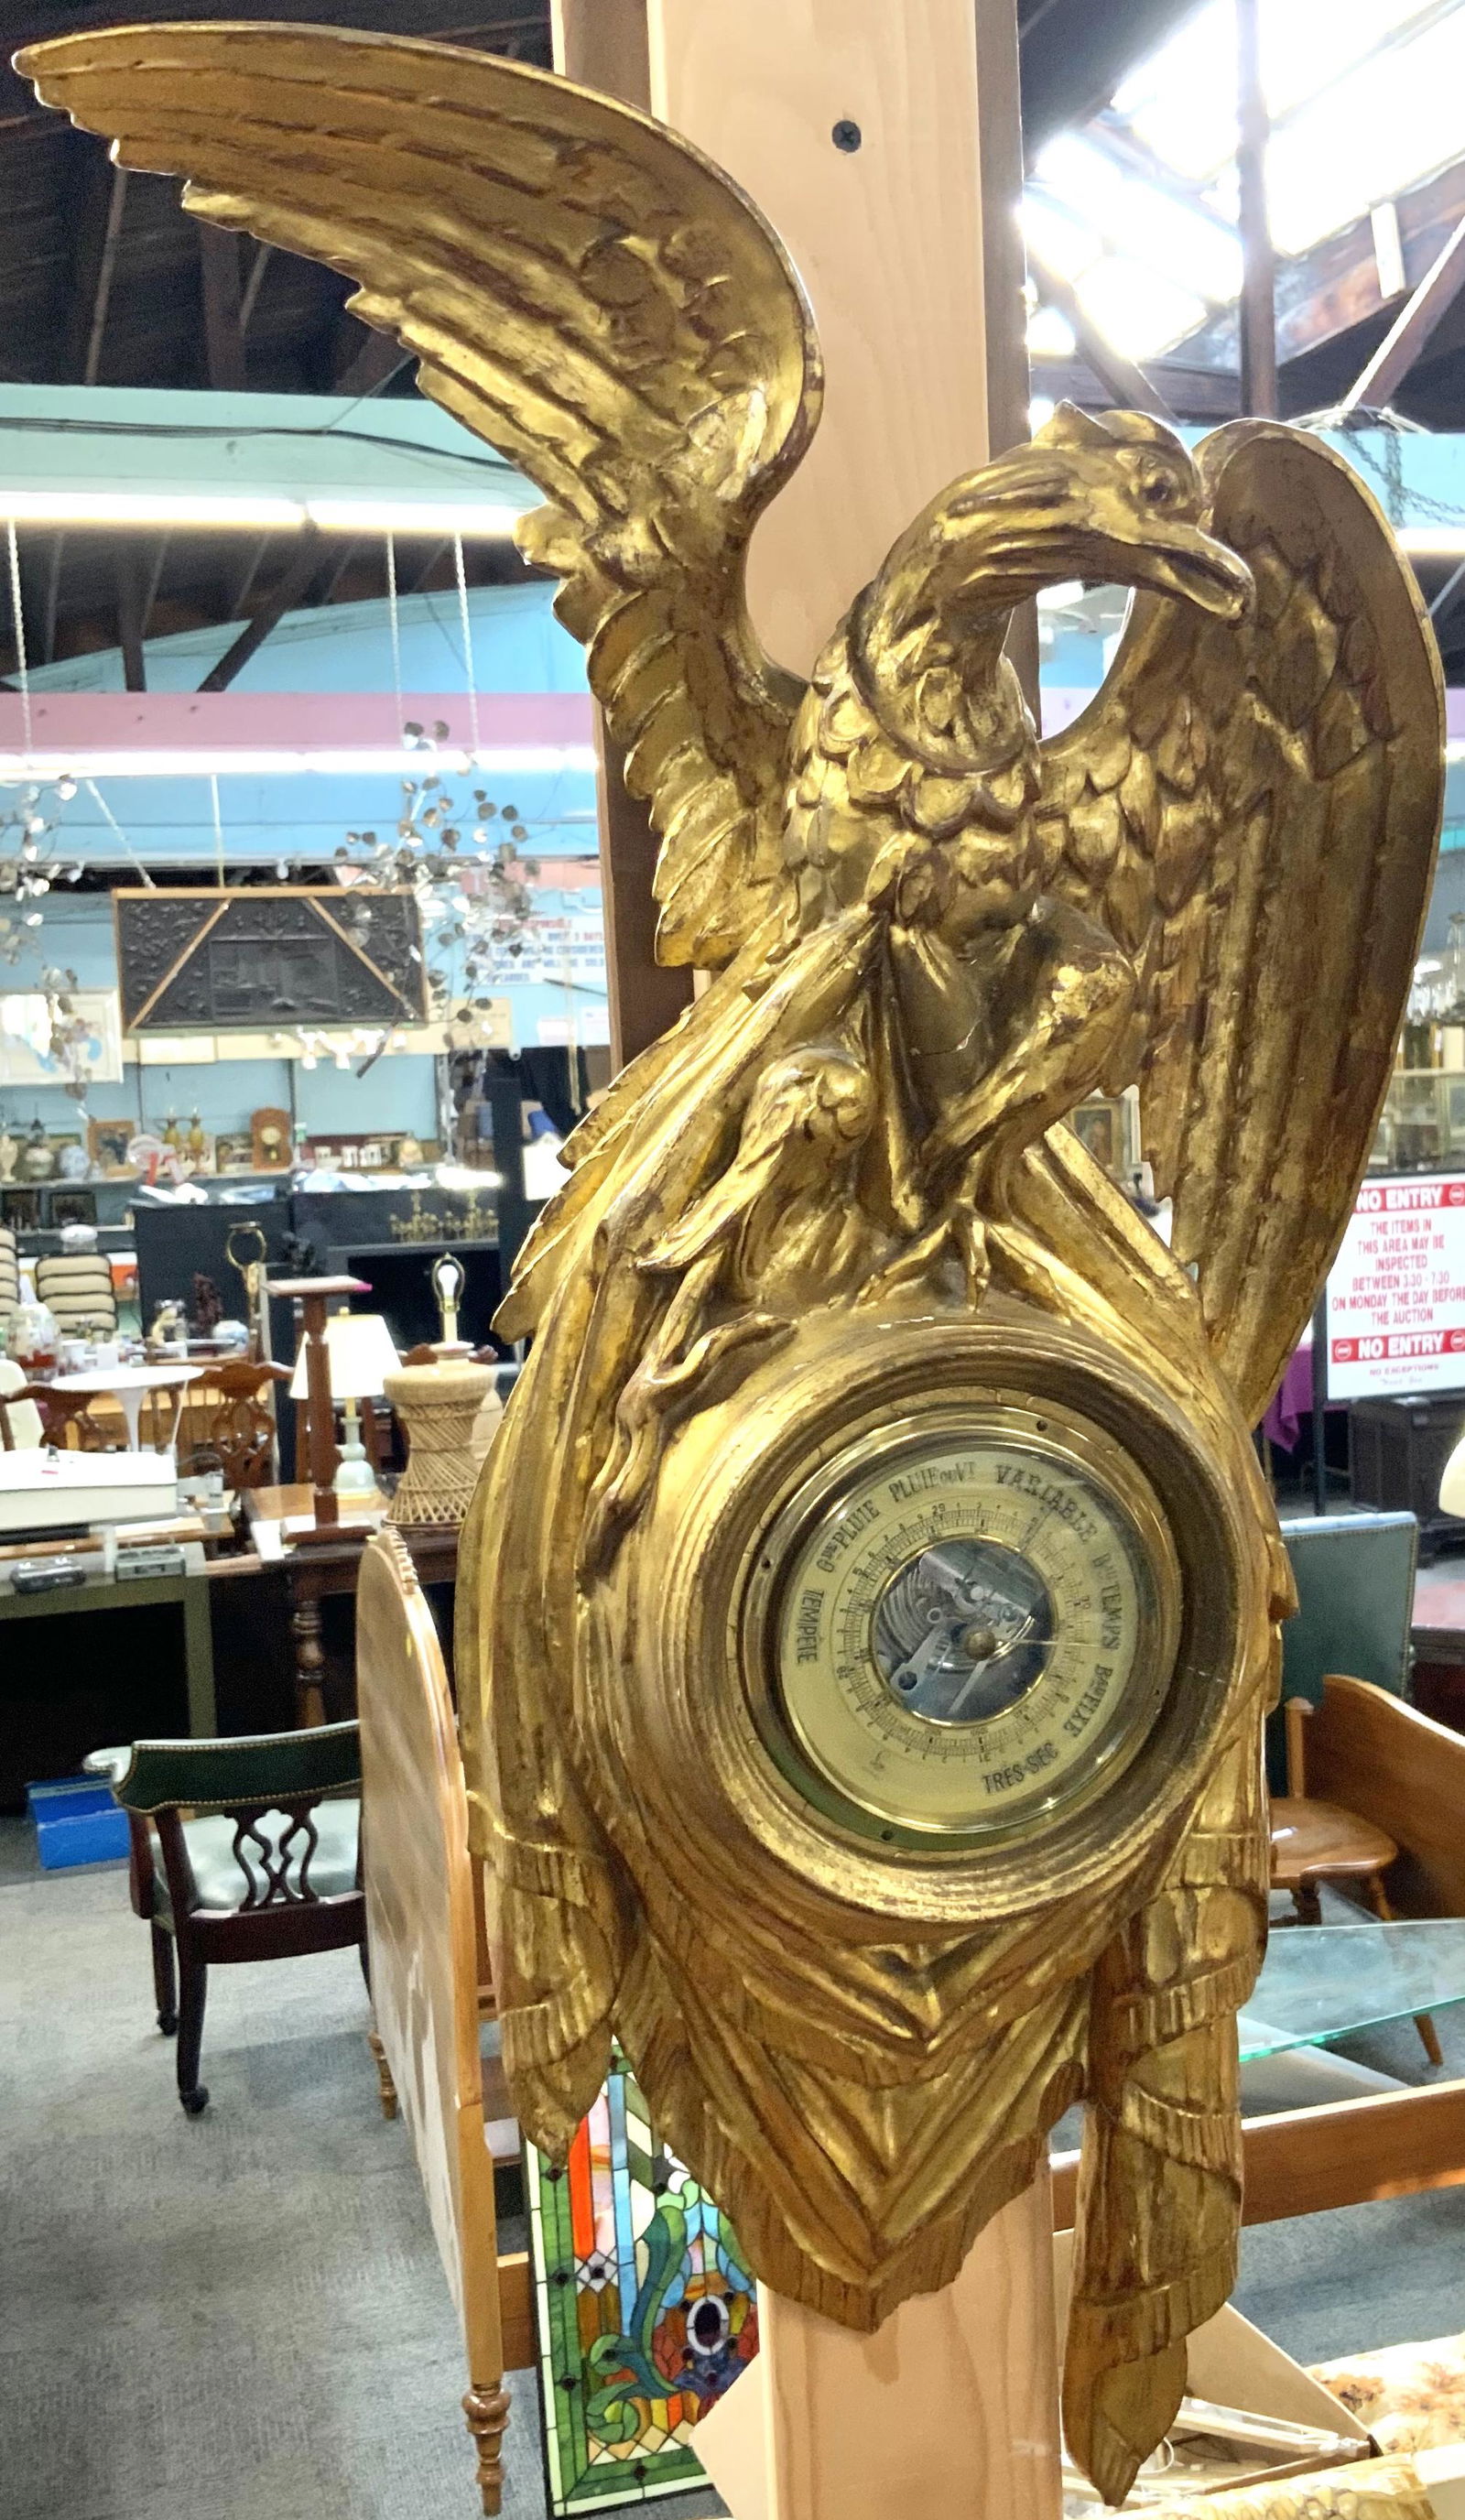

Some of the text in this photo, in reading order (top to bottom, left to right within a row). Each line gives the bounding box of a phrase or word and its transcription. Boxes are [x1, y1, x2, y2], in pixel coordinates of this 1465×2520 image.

[1356, 1185, 1442, 1211] NO ENTRY
[1370, 1218, 1432, 1235] THE ITEMS IN
[1358, 1233, 1445, 1255] THIS AREA MAY BE
[1375, 1254, 1428, 1272] INSPECTED
[1352, 1274, 1400, 1291] BETWEEN
[1332, 1286, 1465, 1311] ON MONDAY THE DAY BEFORE
[1372, 1308, 1434, 1327] THE AUCTION
[1358, 1331, 1445, 1360] NO ENTRY
[932, 1503, 946, 1516] 29
[995, 1464, 1098, 1546] VARIABLE
